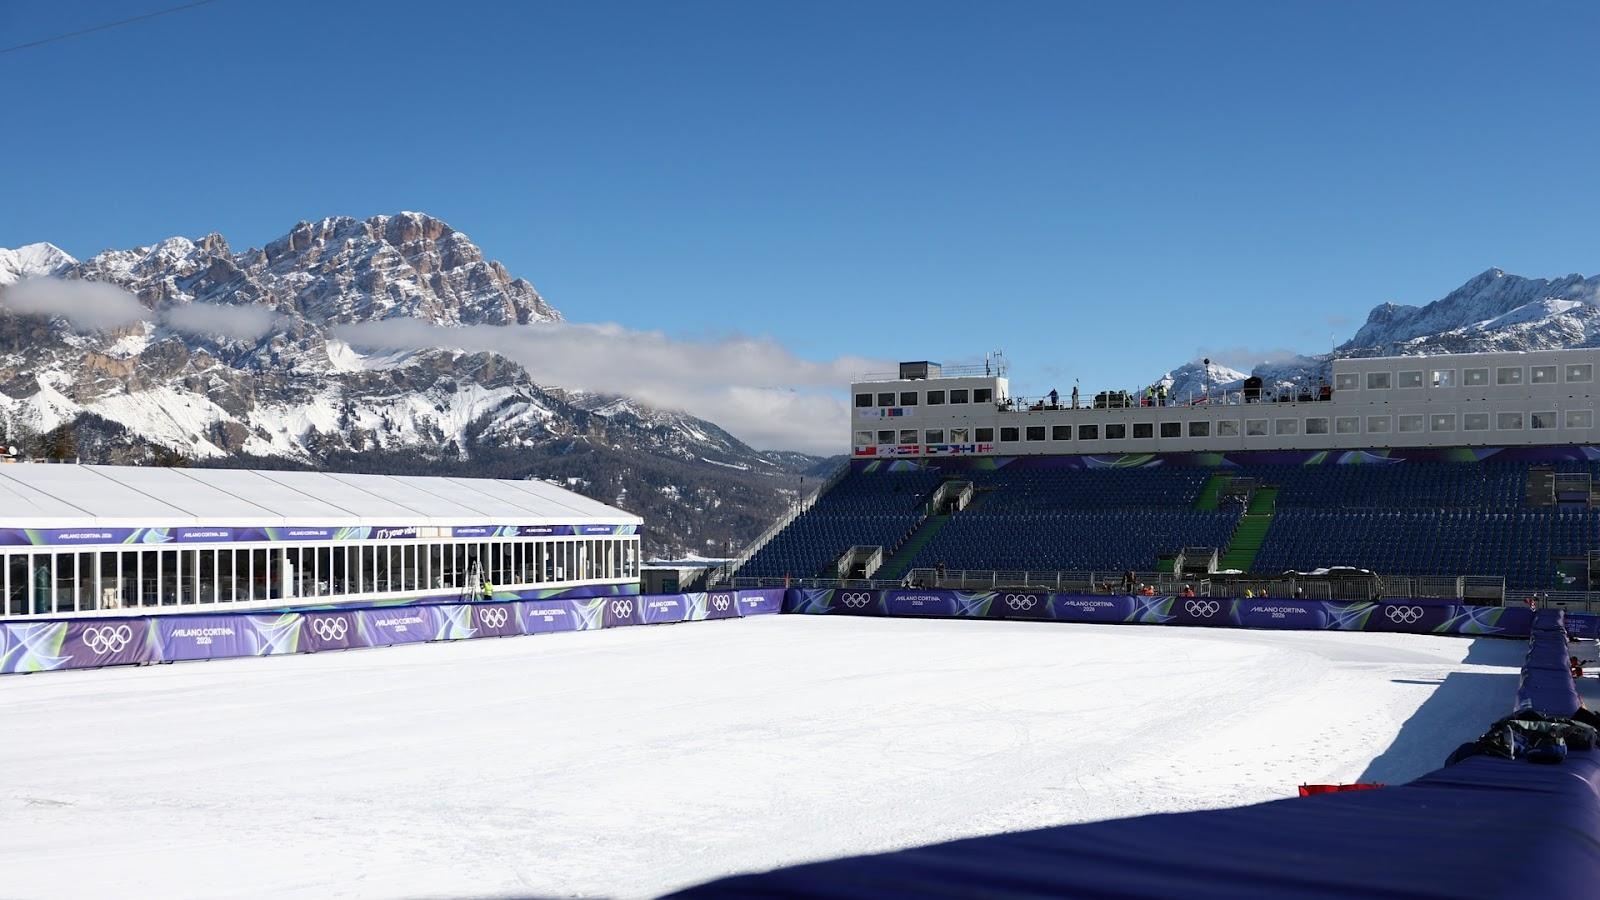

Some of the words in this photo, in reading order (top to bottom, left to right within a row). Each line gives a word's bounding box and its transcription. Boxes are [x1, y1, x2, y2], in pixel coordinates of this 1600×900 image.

[1089, 600, 1115, 608] CORTINA
[375, 618, 398, 627] MILANO
[171, 628, 201, 637] MILANO
[202, 627, 235, 637] CORTINA
[196, 636, 212, 645] 2026
